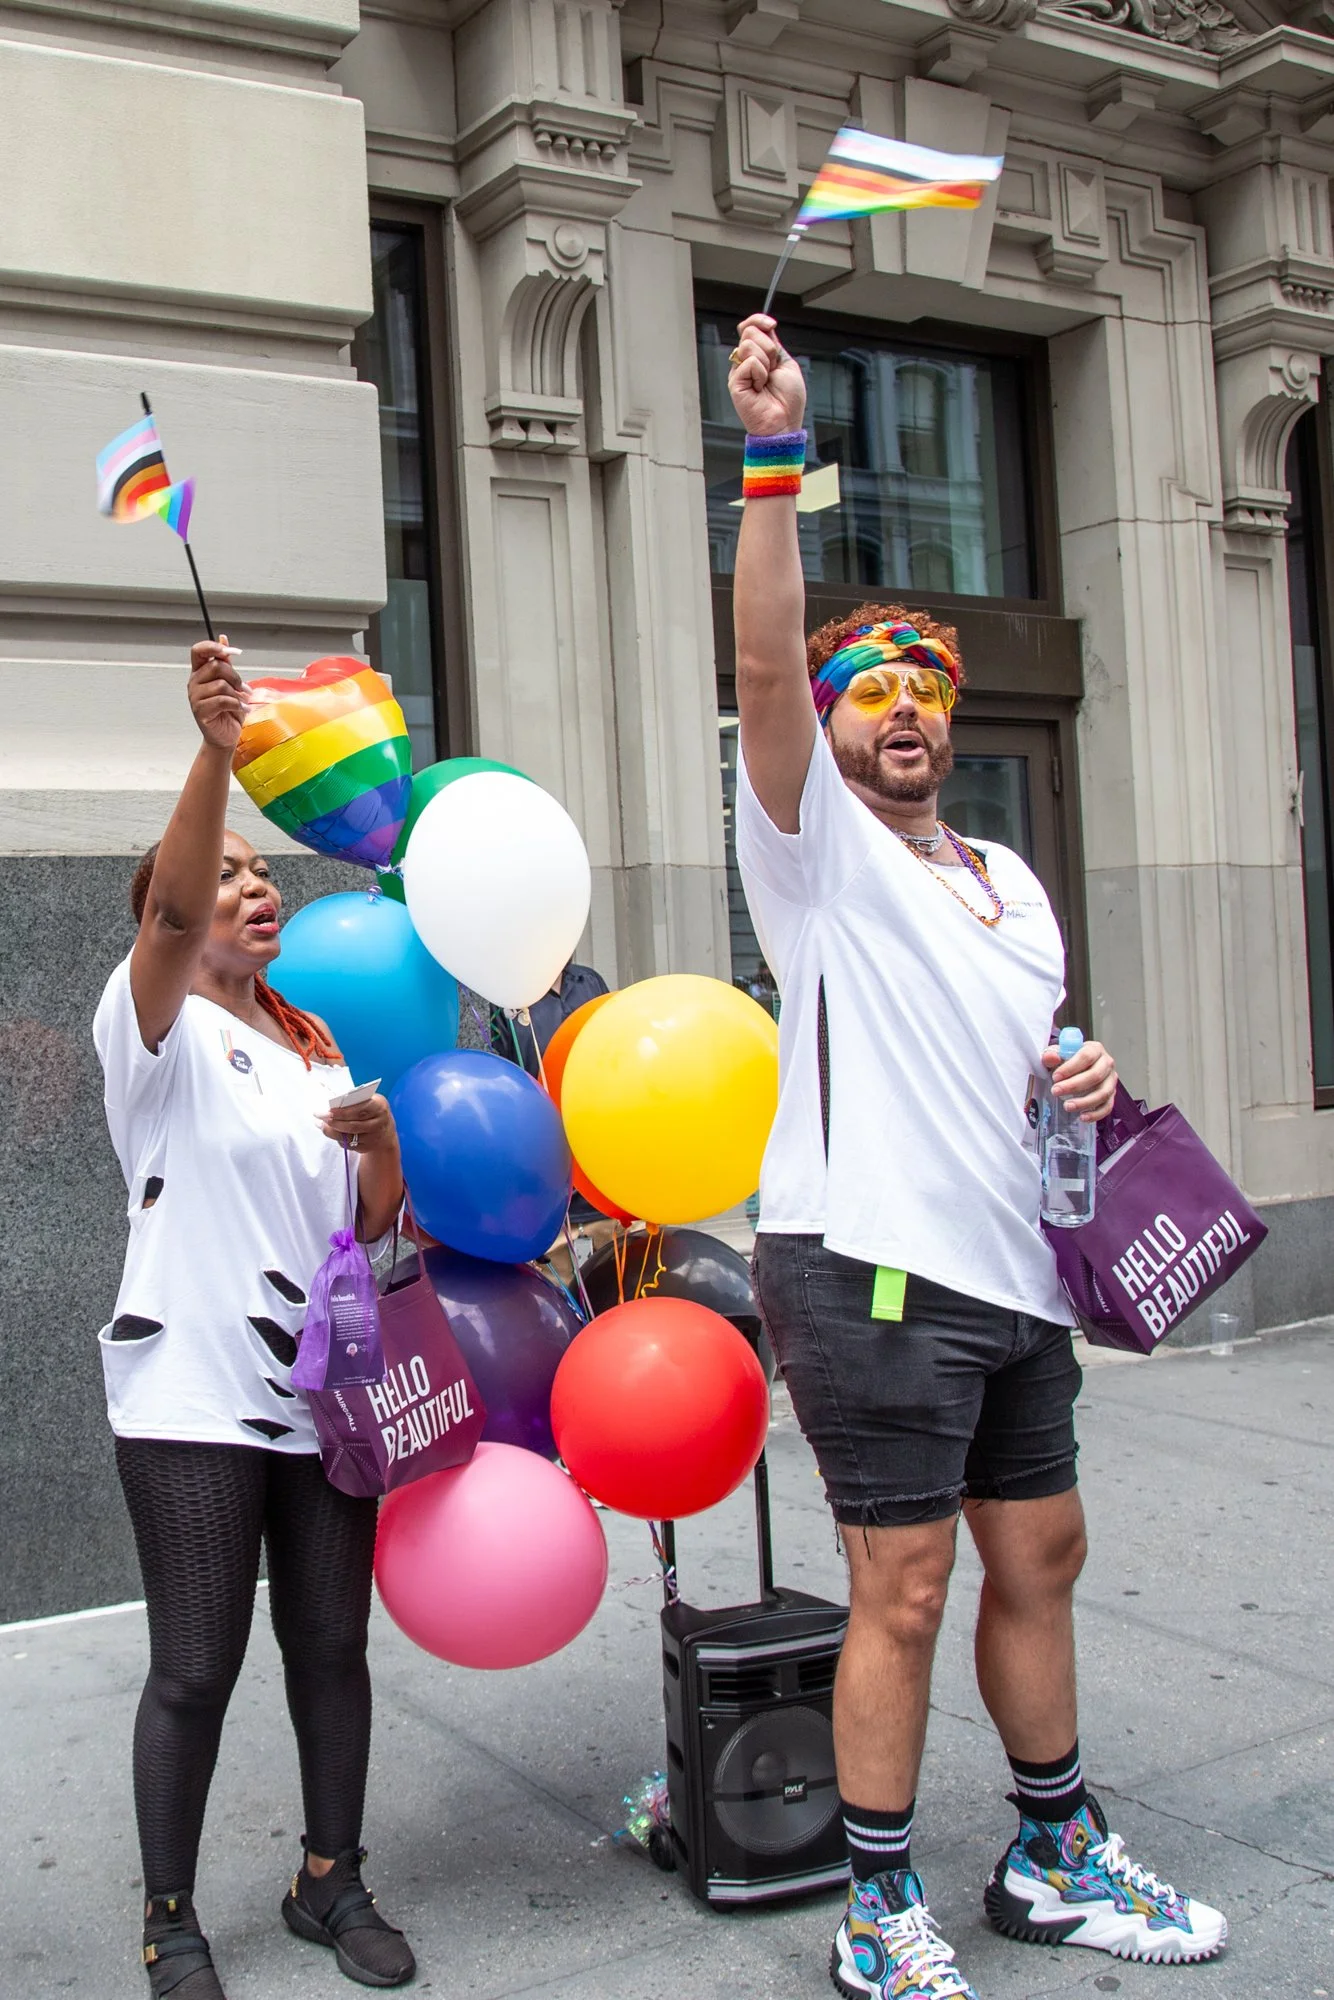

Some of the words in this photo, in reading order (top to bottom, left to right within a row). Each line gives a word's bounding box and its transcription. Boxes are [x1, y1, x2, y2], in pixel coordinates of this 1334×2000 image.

[1112, 1213, 1187, 1301] HELLO
[1137, 1210, 1250, 1339] BEAUTIFUL
[334, 1390, 357, 1432] HAIRGOALS
[365, 1355, 430, 1424] HELLO
[381, 1379, 474, 1468] BEAUTIFUL
[785, 1783, 804, 1795] PYLE
